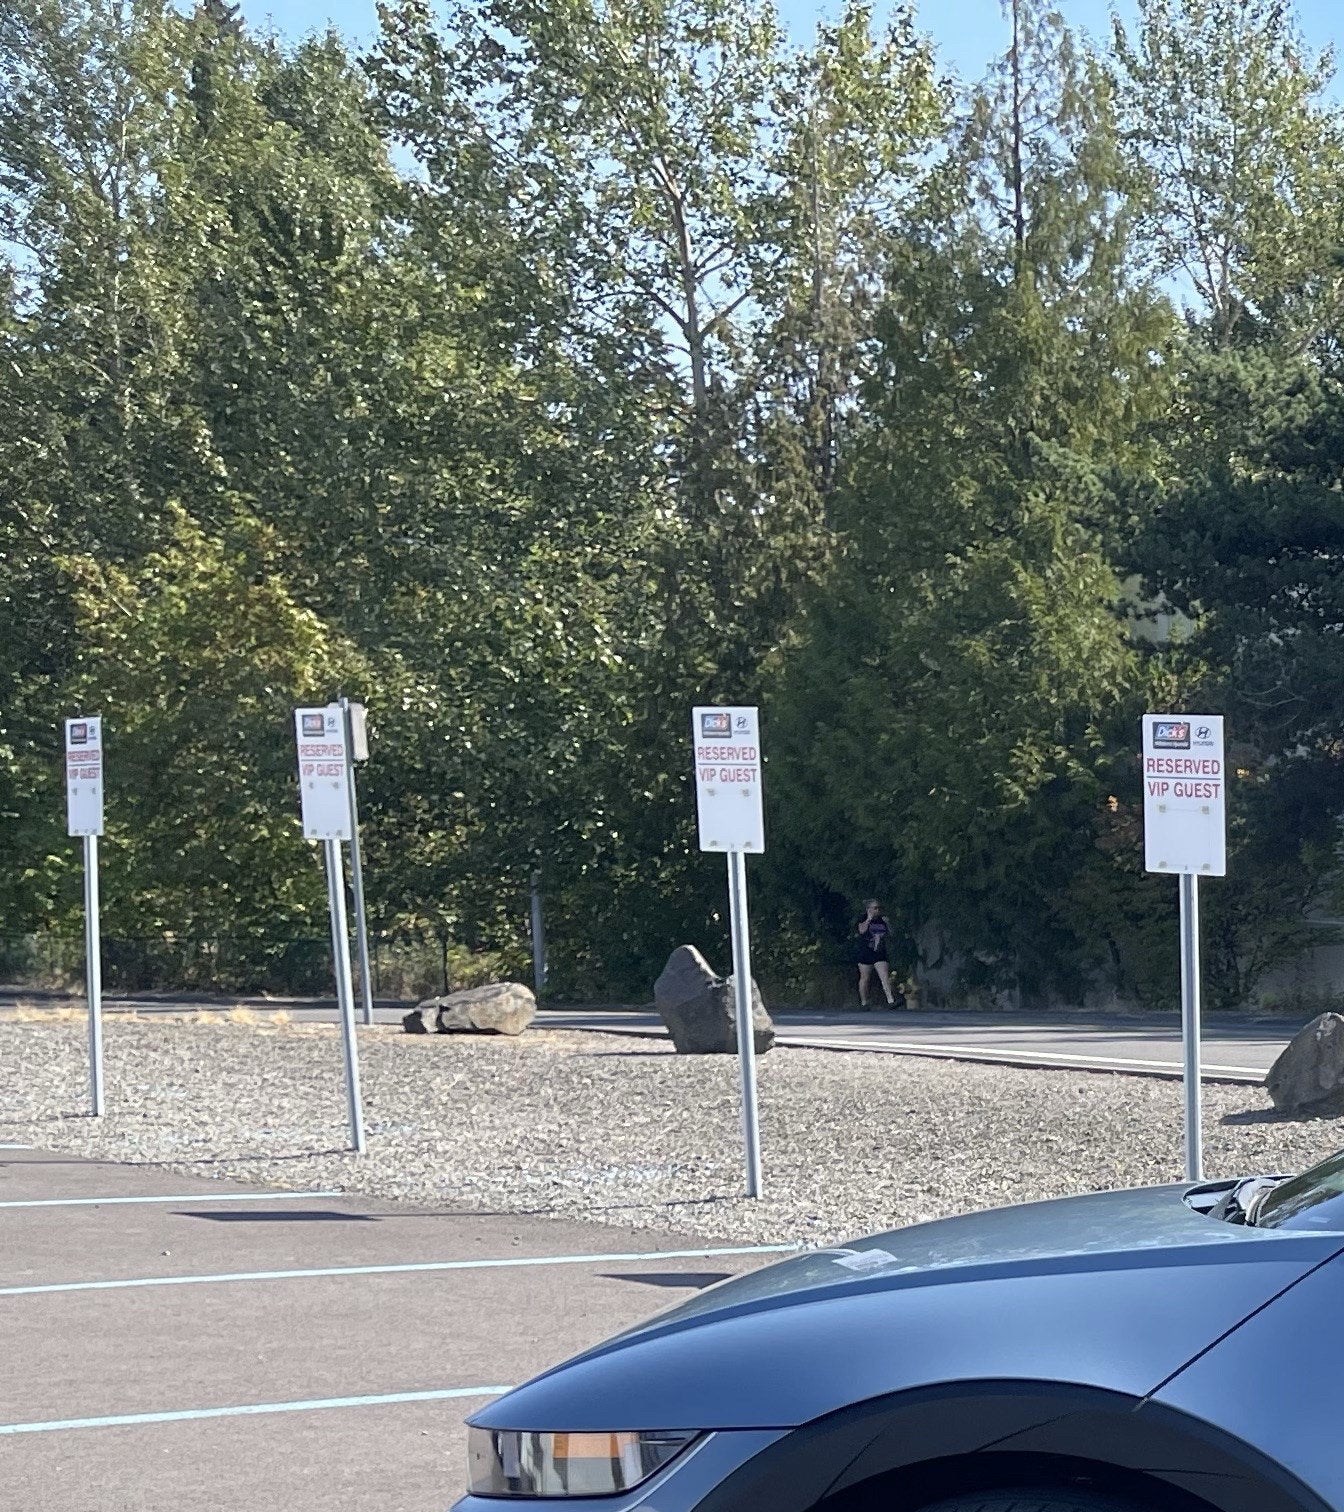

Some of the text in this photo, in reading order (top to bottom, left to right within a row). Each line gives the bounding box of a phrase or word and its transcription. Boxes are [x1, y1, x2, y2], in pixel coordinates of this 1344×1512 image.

[697, 746, 757, 761] RESERVED
[1146, 757, 1220, 774] RESERVED
[698, 767, 757, 782] VIP GUEST
[1147, 781, 1221, 799] VIP GUEST
